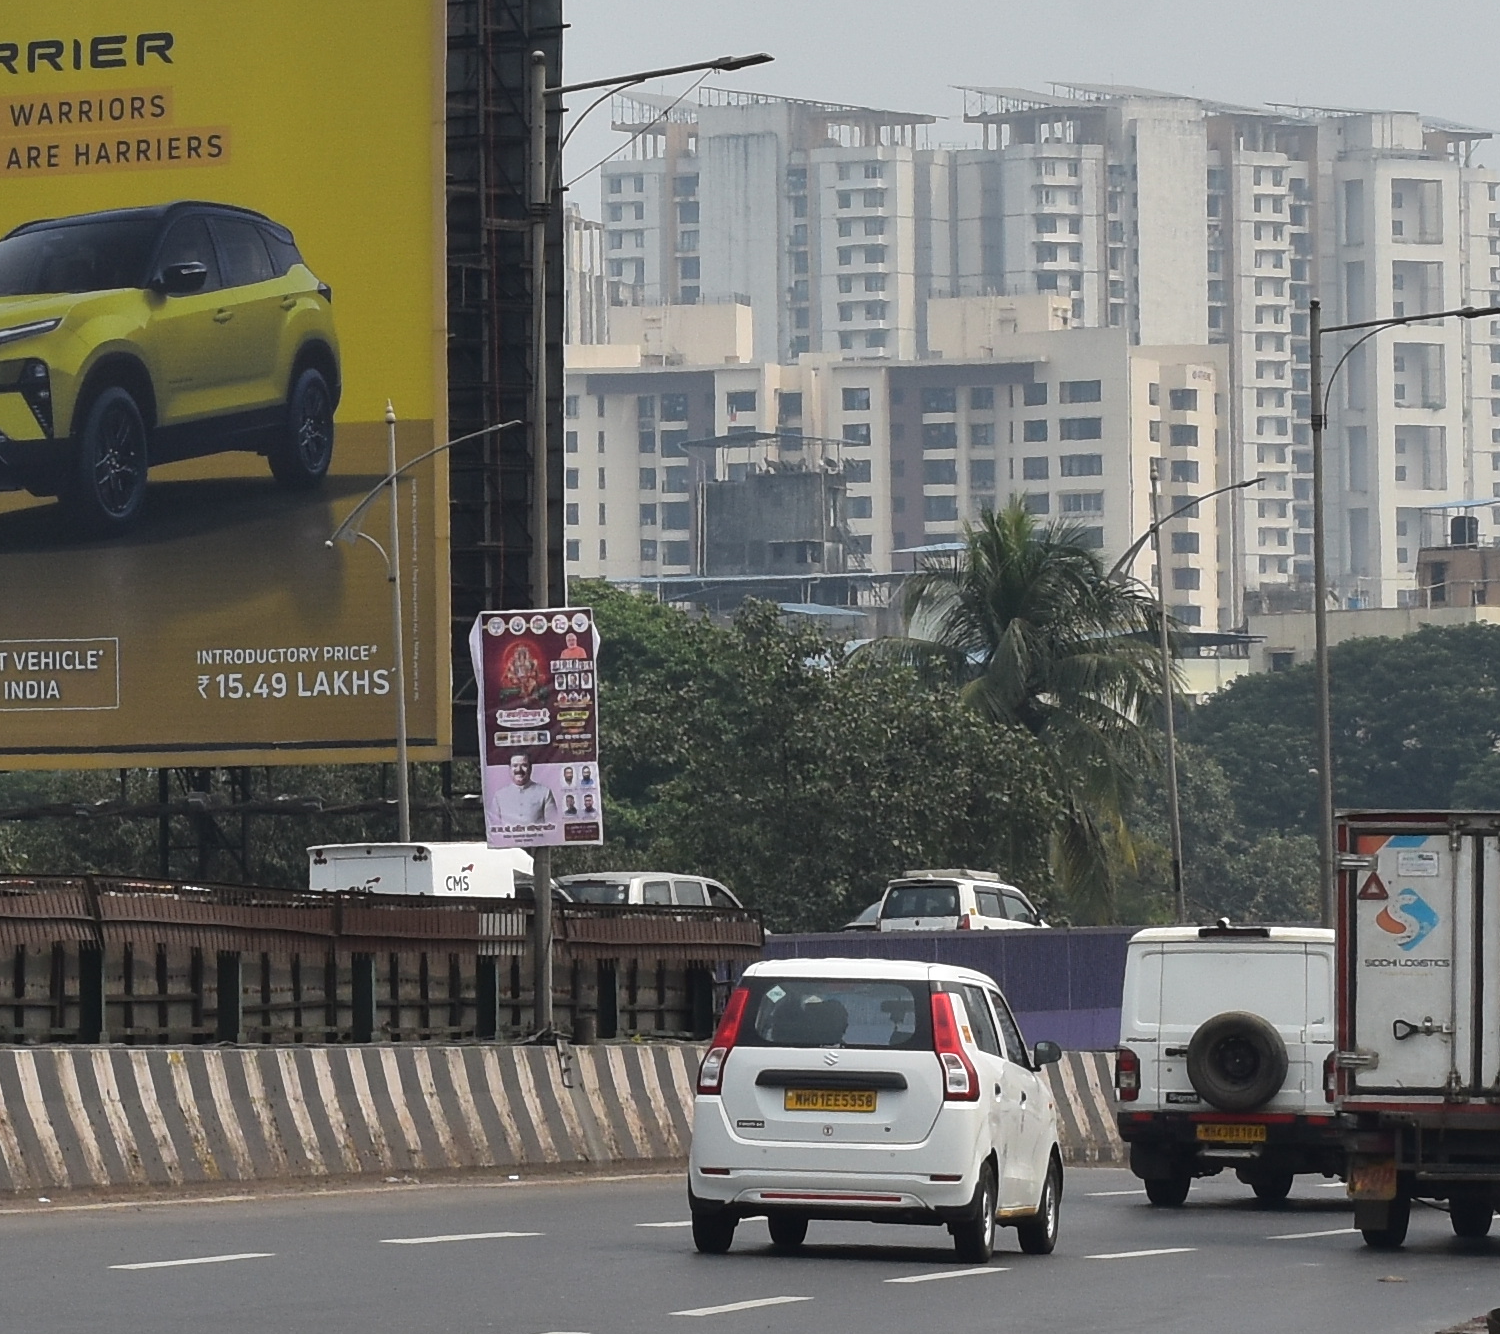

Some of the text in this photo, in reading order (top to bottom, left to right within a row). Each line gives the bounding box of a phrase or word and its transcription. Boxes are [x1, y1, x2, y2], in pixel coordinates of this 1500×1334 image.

[10, 95, 165, 127] WARRIORS
[6, 145, 60, 170] ARE
[75, 135, 223, 167] HARRIERS
[196, 645, 378, 665] INTRODUCTORY PRICE#
[4, 680, 60, 700] INDIA
[445, 875, 470, 892] CMS
[1364, 958, 1450, 968] SIDDHI LOGISTICS
